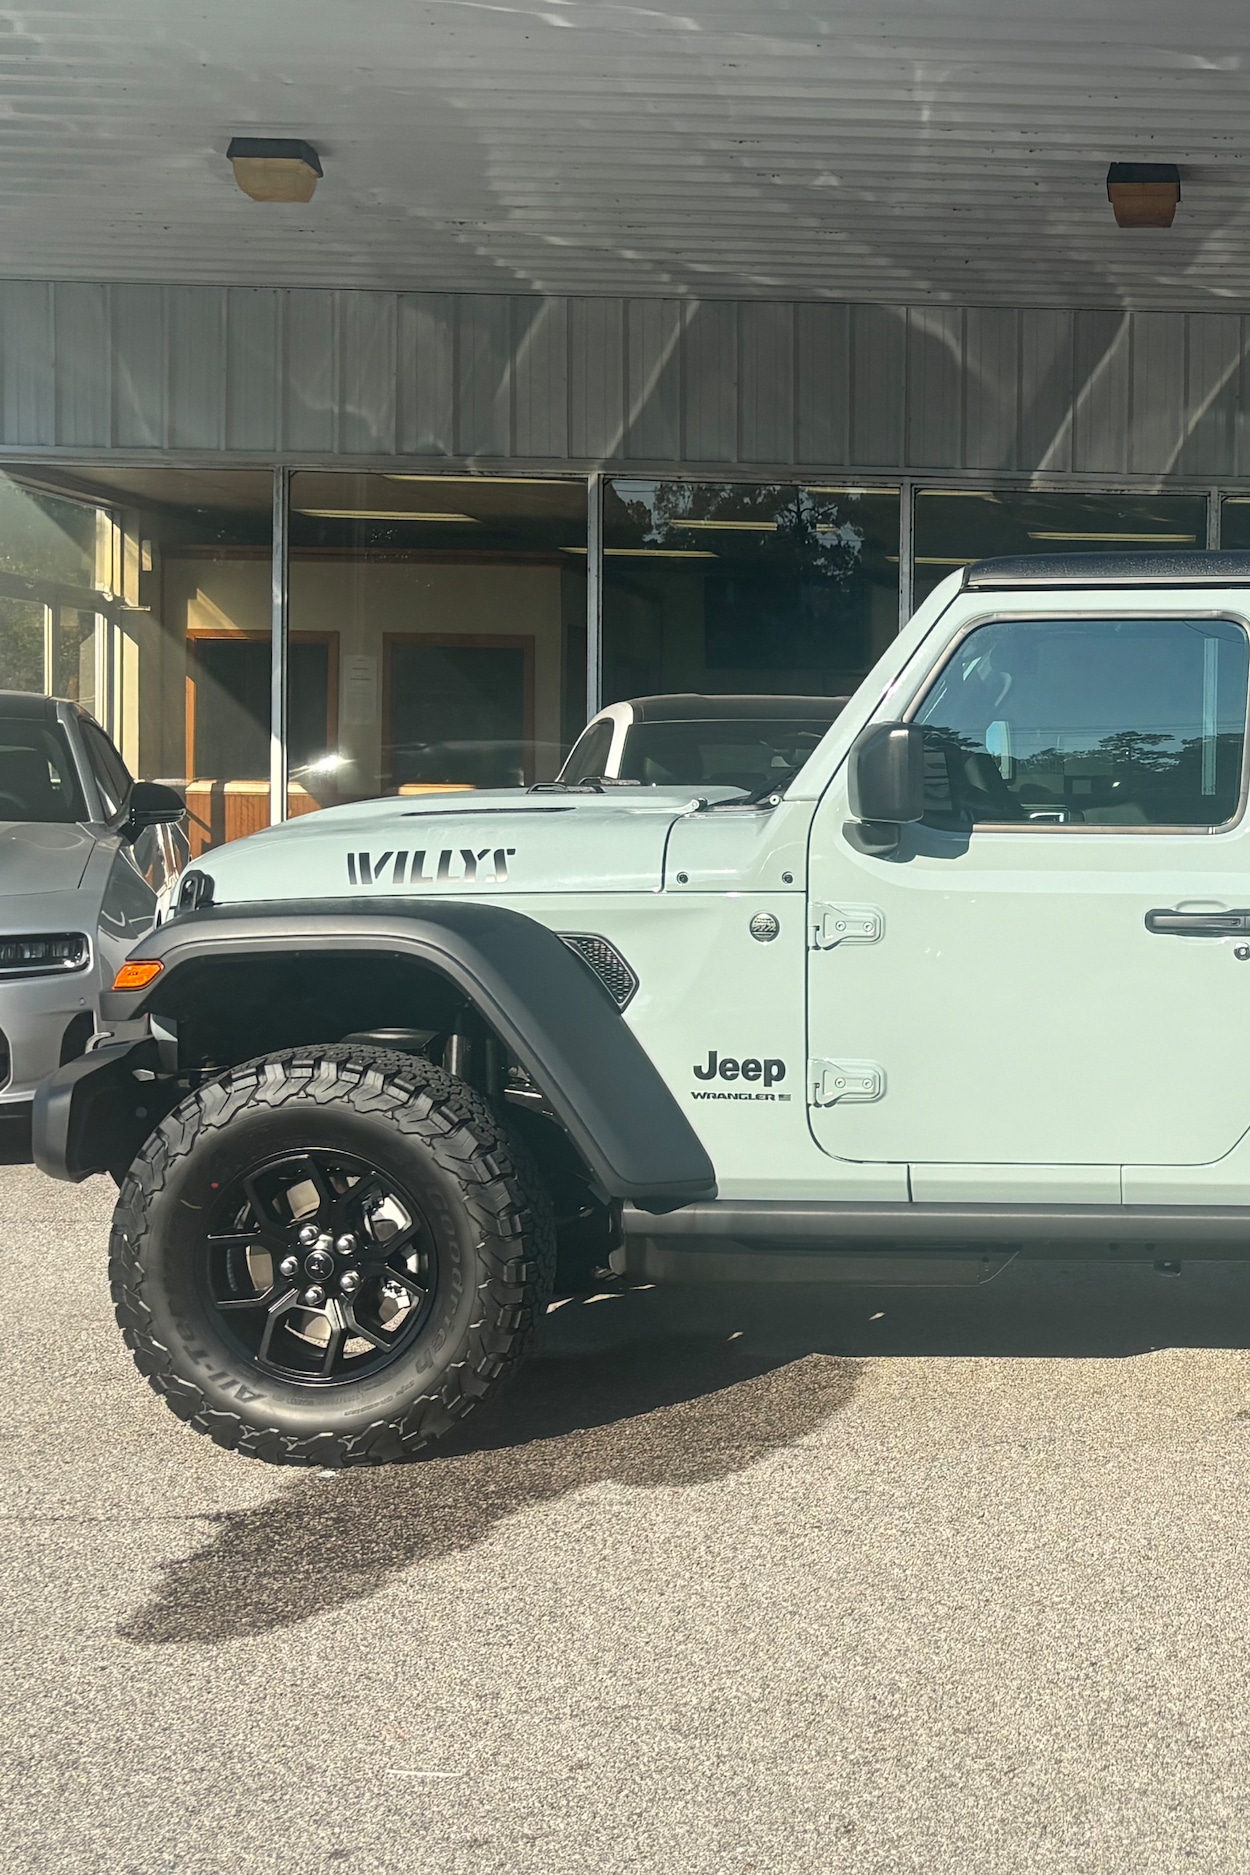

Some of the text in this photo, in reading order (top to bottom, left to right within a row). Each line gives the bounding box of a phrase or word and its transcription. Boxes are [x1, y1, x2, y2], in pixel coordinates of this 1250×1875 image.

[347, 848, 516, 885] WILLYS
[692, 1050, 786, 1087] Jeep
[690, 1091, 776, 1101] WRANGLER
